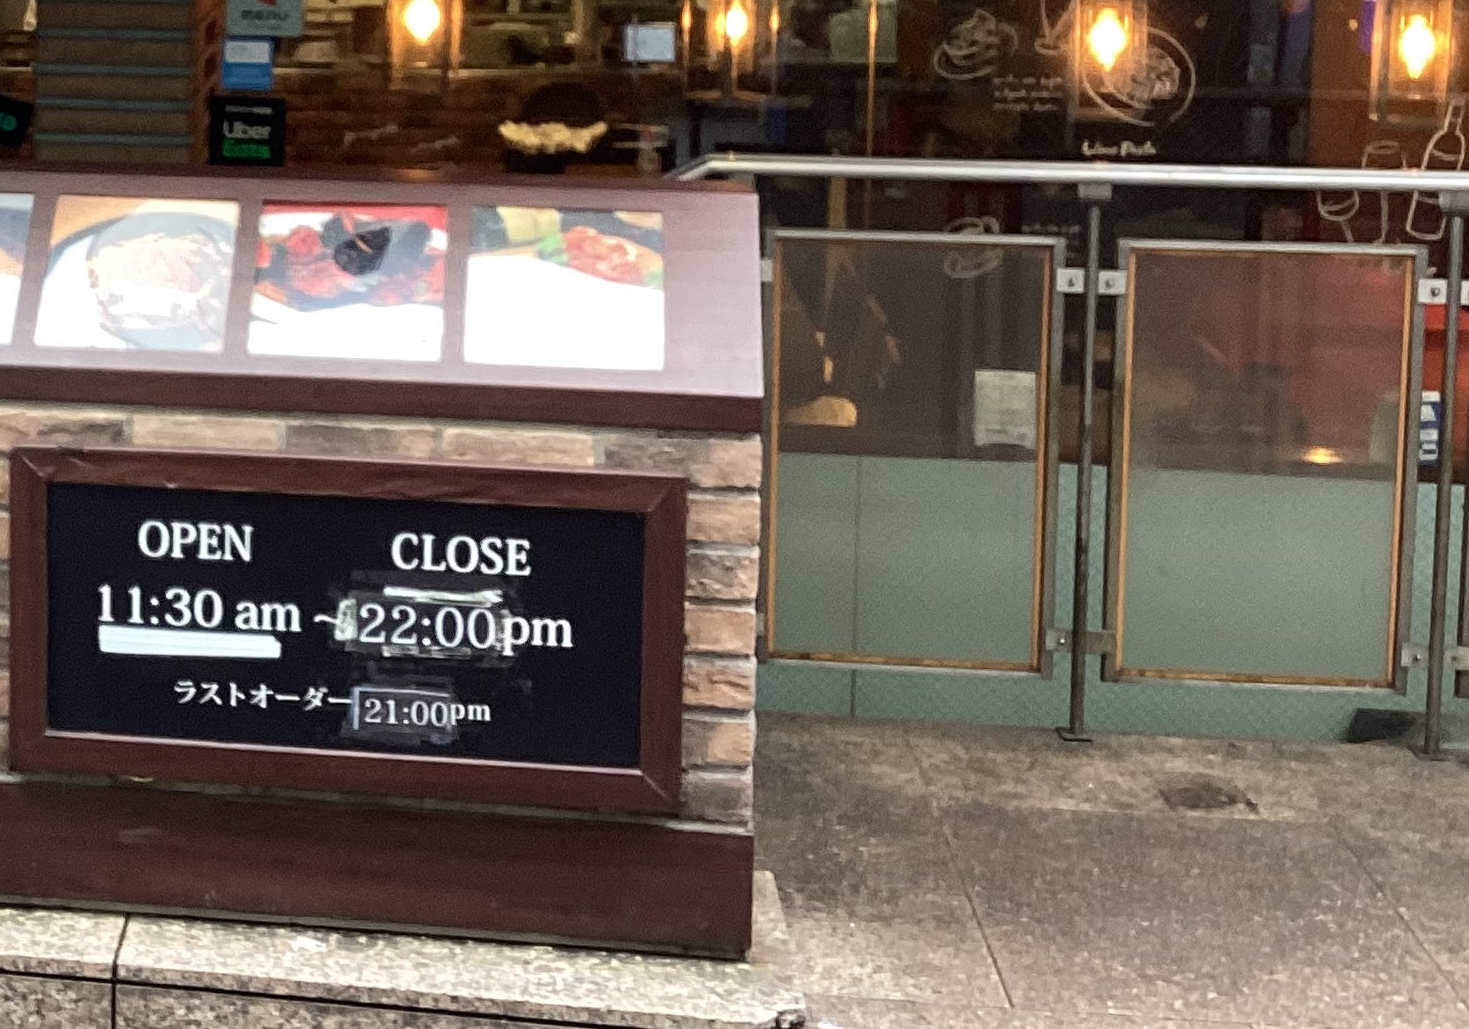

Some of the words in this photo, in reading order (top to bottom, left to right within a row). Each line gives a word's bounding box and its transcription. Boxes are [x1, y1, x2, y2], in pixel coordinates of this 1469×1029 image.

[138, 519, 254, 563] OPEN
[390, 533, 532, 577] CLOSE
[97, 584, 224, 628] 11:30
[234, 599, 303, 633] am
[173, 679, 352, 712] ラストオーダー
